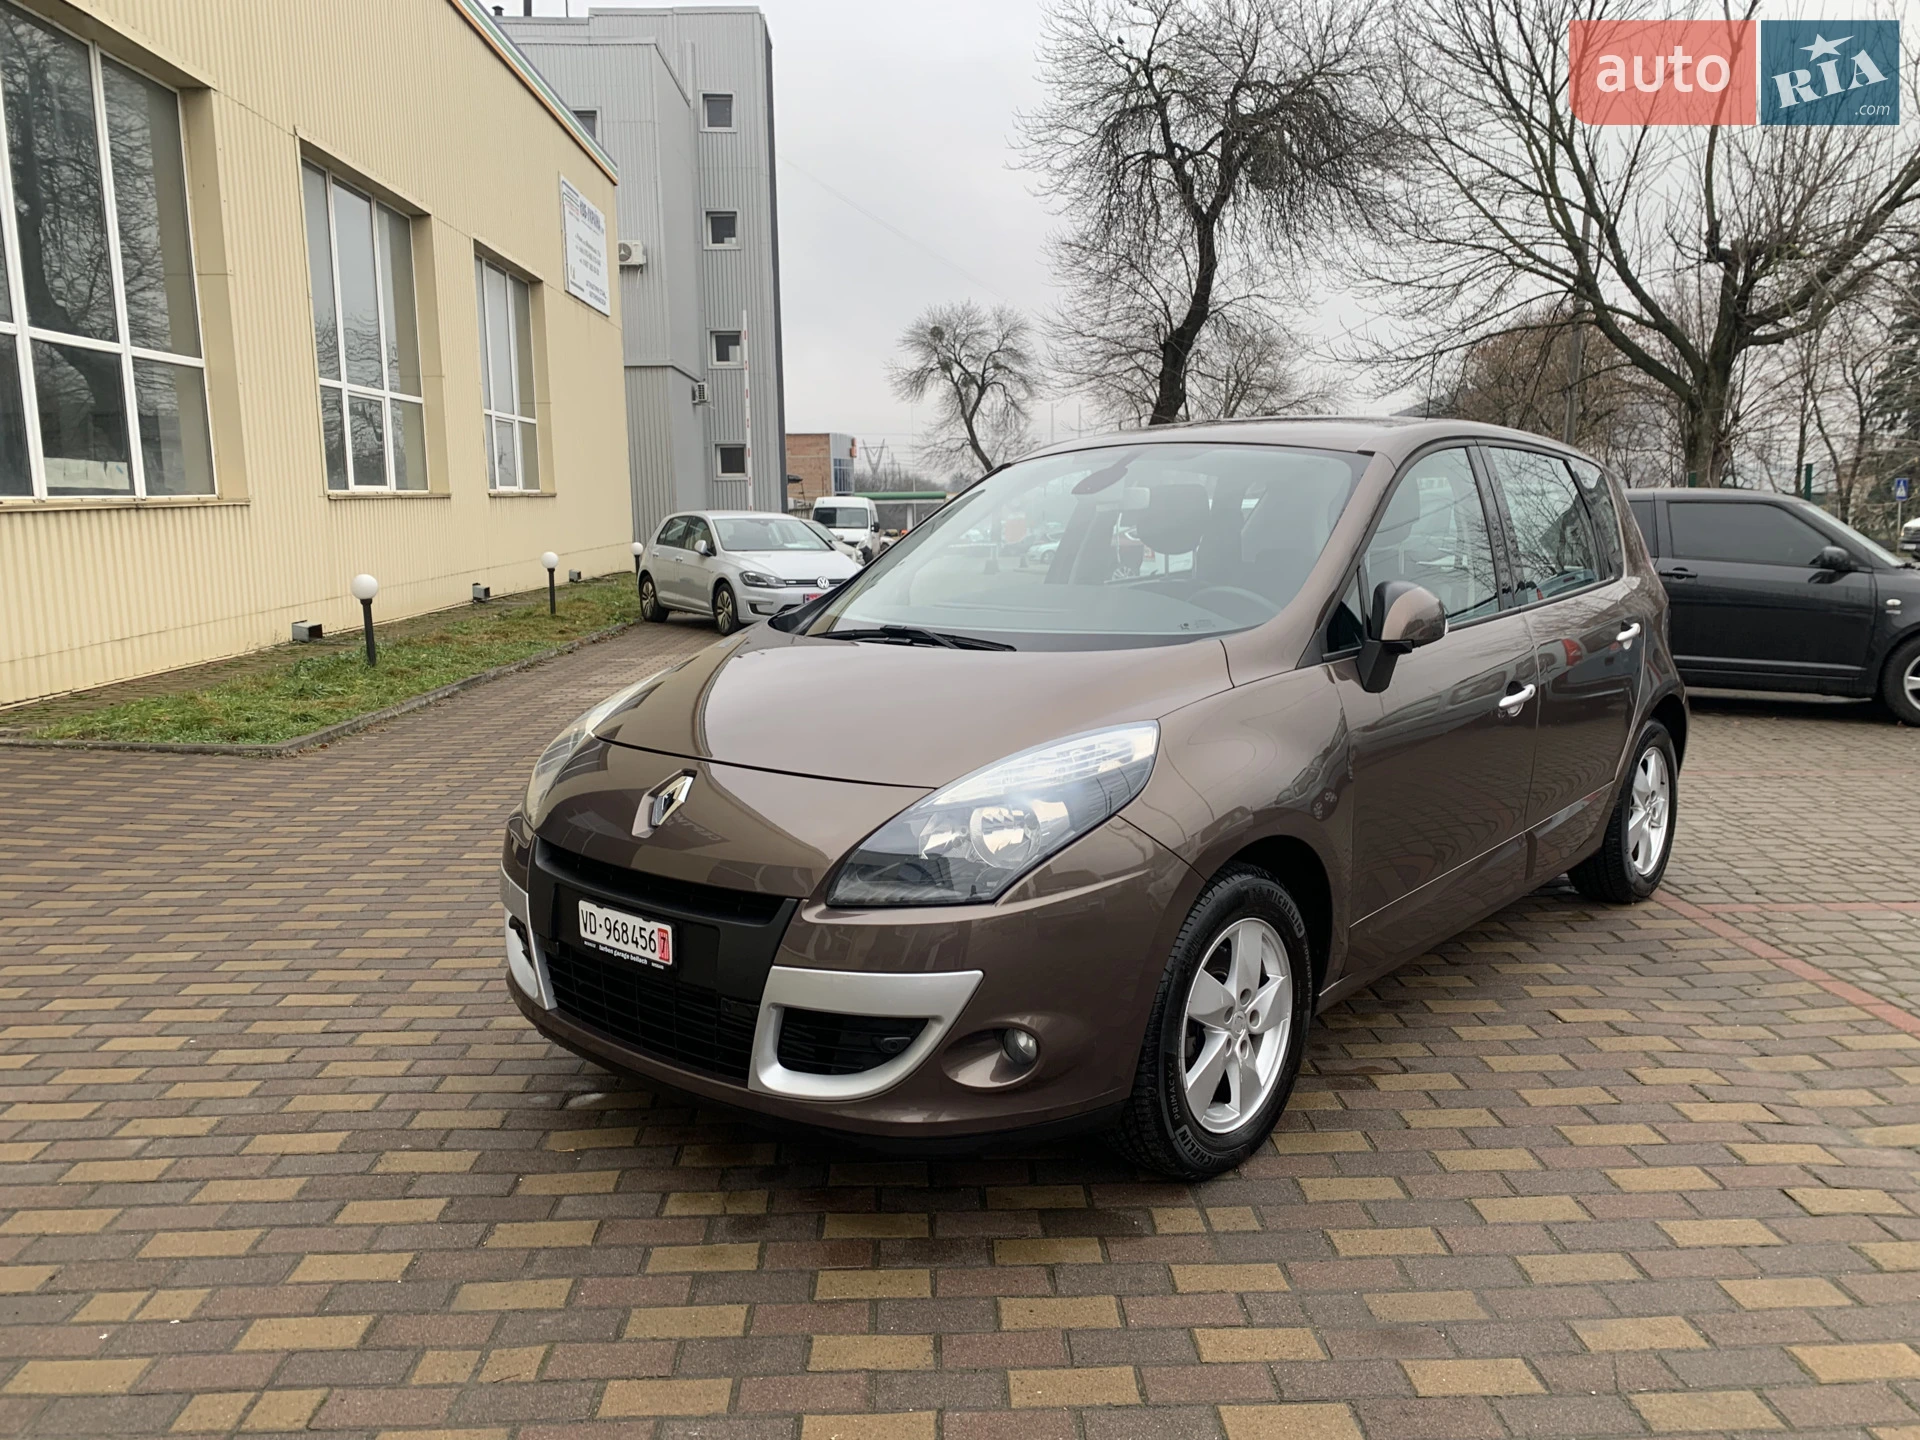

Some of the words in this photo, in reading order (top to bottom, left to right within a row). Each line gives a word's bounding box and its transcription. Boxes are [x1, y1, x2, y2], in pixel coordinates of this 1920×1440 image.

[1266, 888, 1303, 935] MICHELIN
[1167, 1070, 1181, 1119] PRIMACY
[1178, 1129, 1226, 1165] MICHELIN
